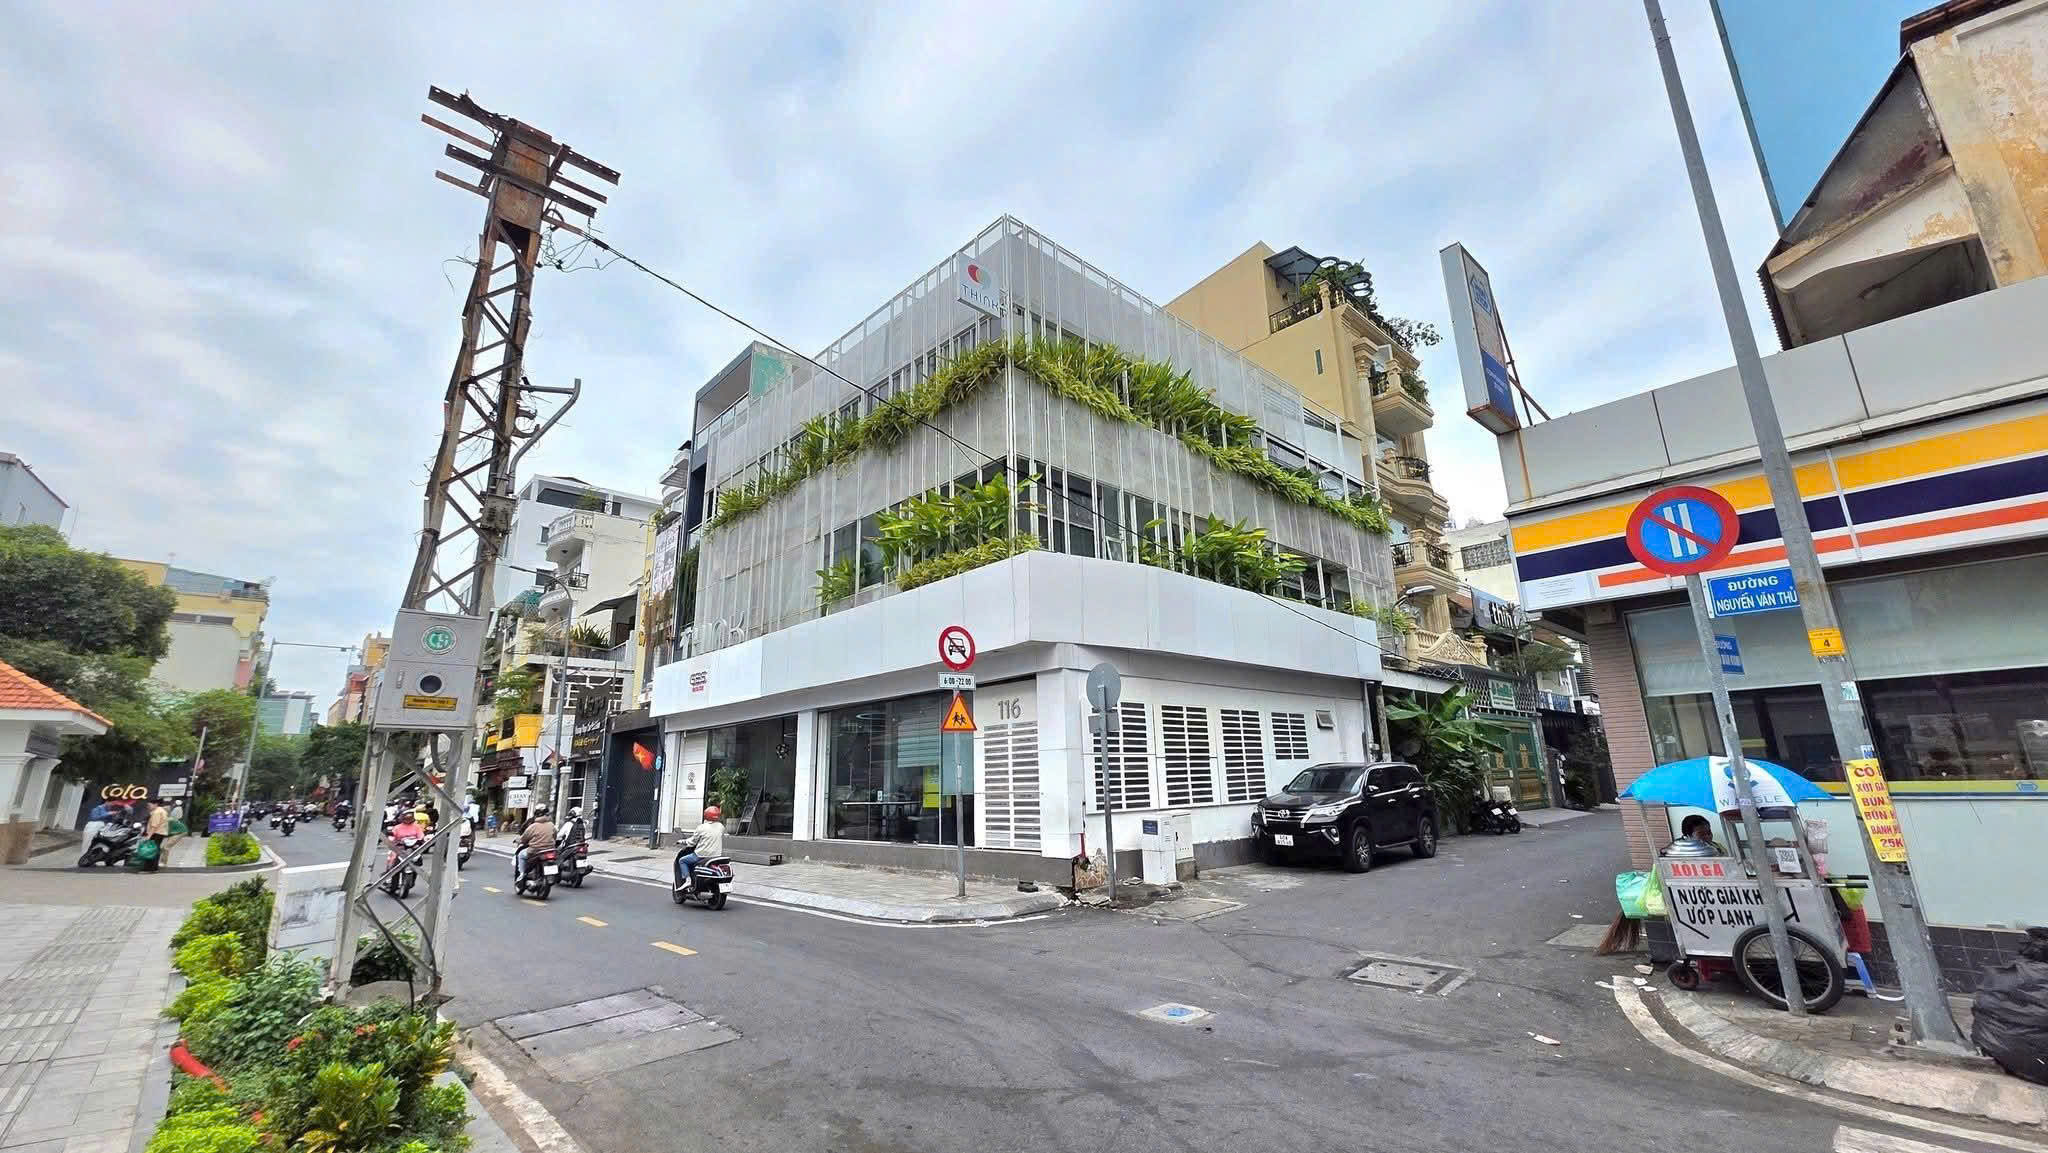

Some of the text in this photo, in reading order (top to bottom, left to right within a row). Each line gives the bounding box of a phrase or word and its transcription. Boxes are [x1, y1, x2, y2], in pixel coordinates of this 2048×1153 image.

[1727, 575, 1779, 592] ĐƯỜNG
[1715, 585, 1798, 612] NGUYỄN VĂN THỦ
[1823, 639, 1831, 648] 4
[998, 697, 1021, 720] 116
[1854, 763, 1875, 778] CÔ
[1880, 838, 1904, 848] 25K
[1677, 886, 1716, 905] NƯỚC
[1718, 910, 1757, 928] LẠNH
